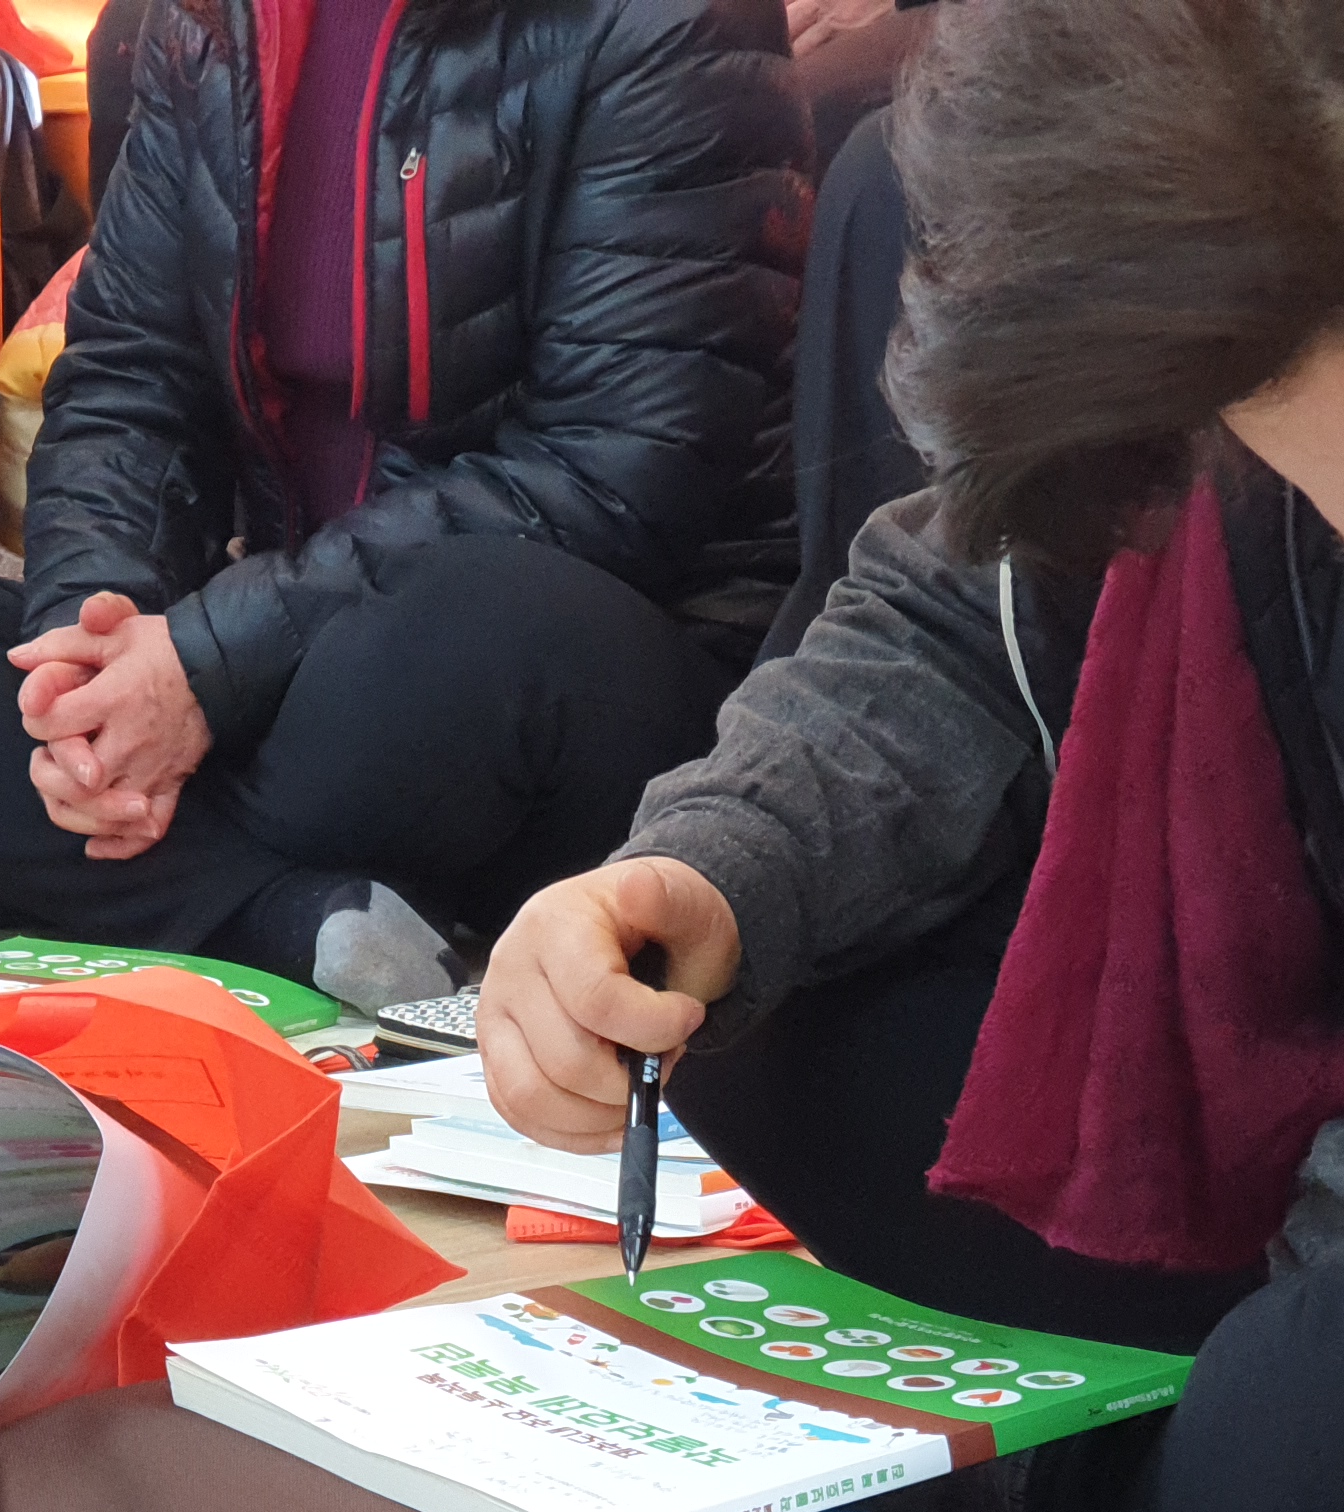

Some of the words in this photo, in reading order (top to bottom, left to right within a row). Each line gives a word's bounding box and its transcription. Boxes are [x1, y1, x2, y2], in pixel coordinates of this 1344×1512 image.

[410, 1341, 541, 1396] 목록집
[416, 1372, 512, 1410] 소득작목
[502, 1409, 554, 1434] 주요
[529, 1393, 743, 1470] 작물보호제
[551, 1425, 648, 1461] 제주도내
